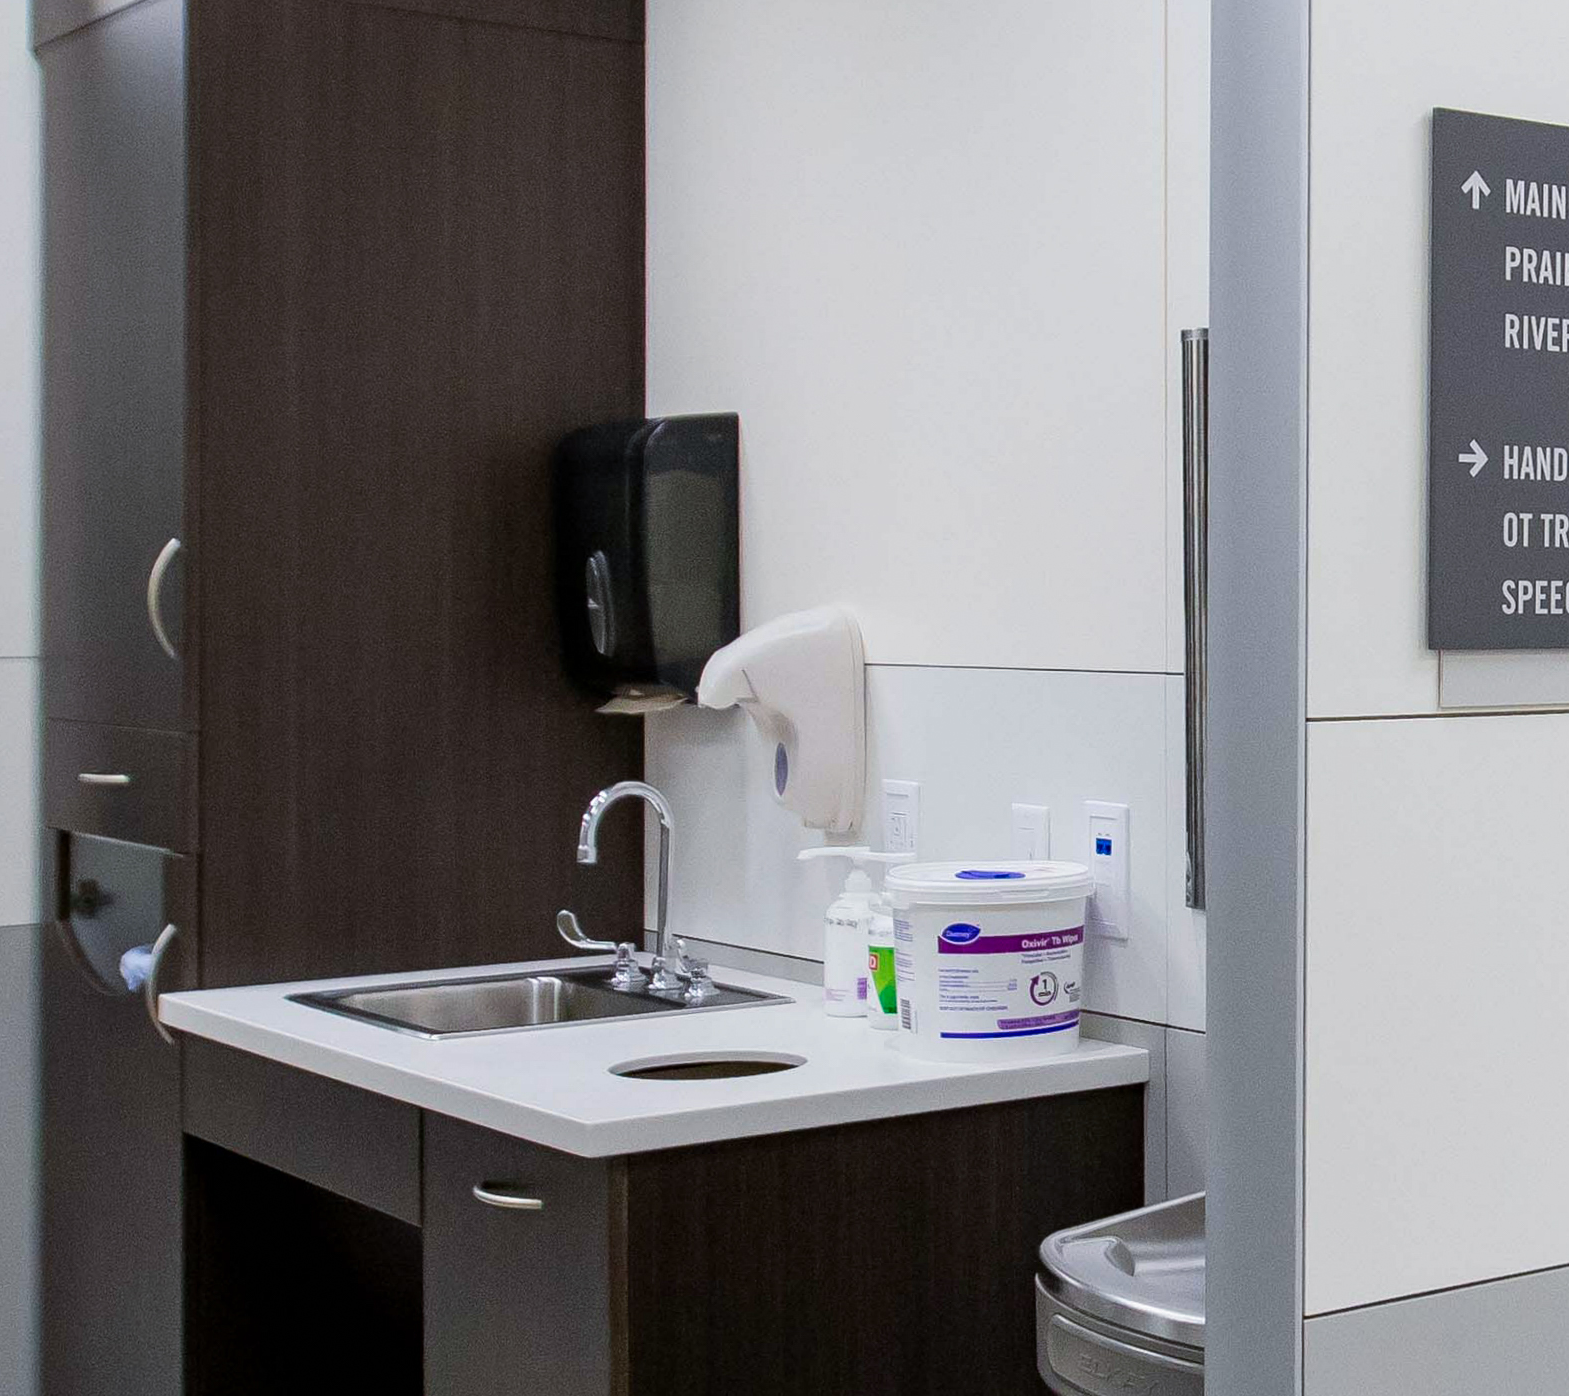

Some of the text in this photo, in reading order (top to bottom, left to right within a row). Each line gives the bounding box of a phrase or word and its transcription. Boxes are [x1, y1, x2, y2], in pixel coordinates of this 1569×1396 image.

[1505, 178, 1567, 220] MAIN
[1503, 444, 1568, 482] HAND
[1503, 512, 1534, 548] OT
[1021, 937, 1048, 949] Oxivir
[1051, 936, 1061, 946] Tb
